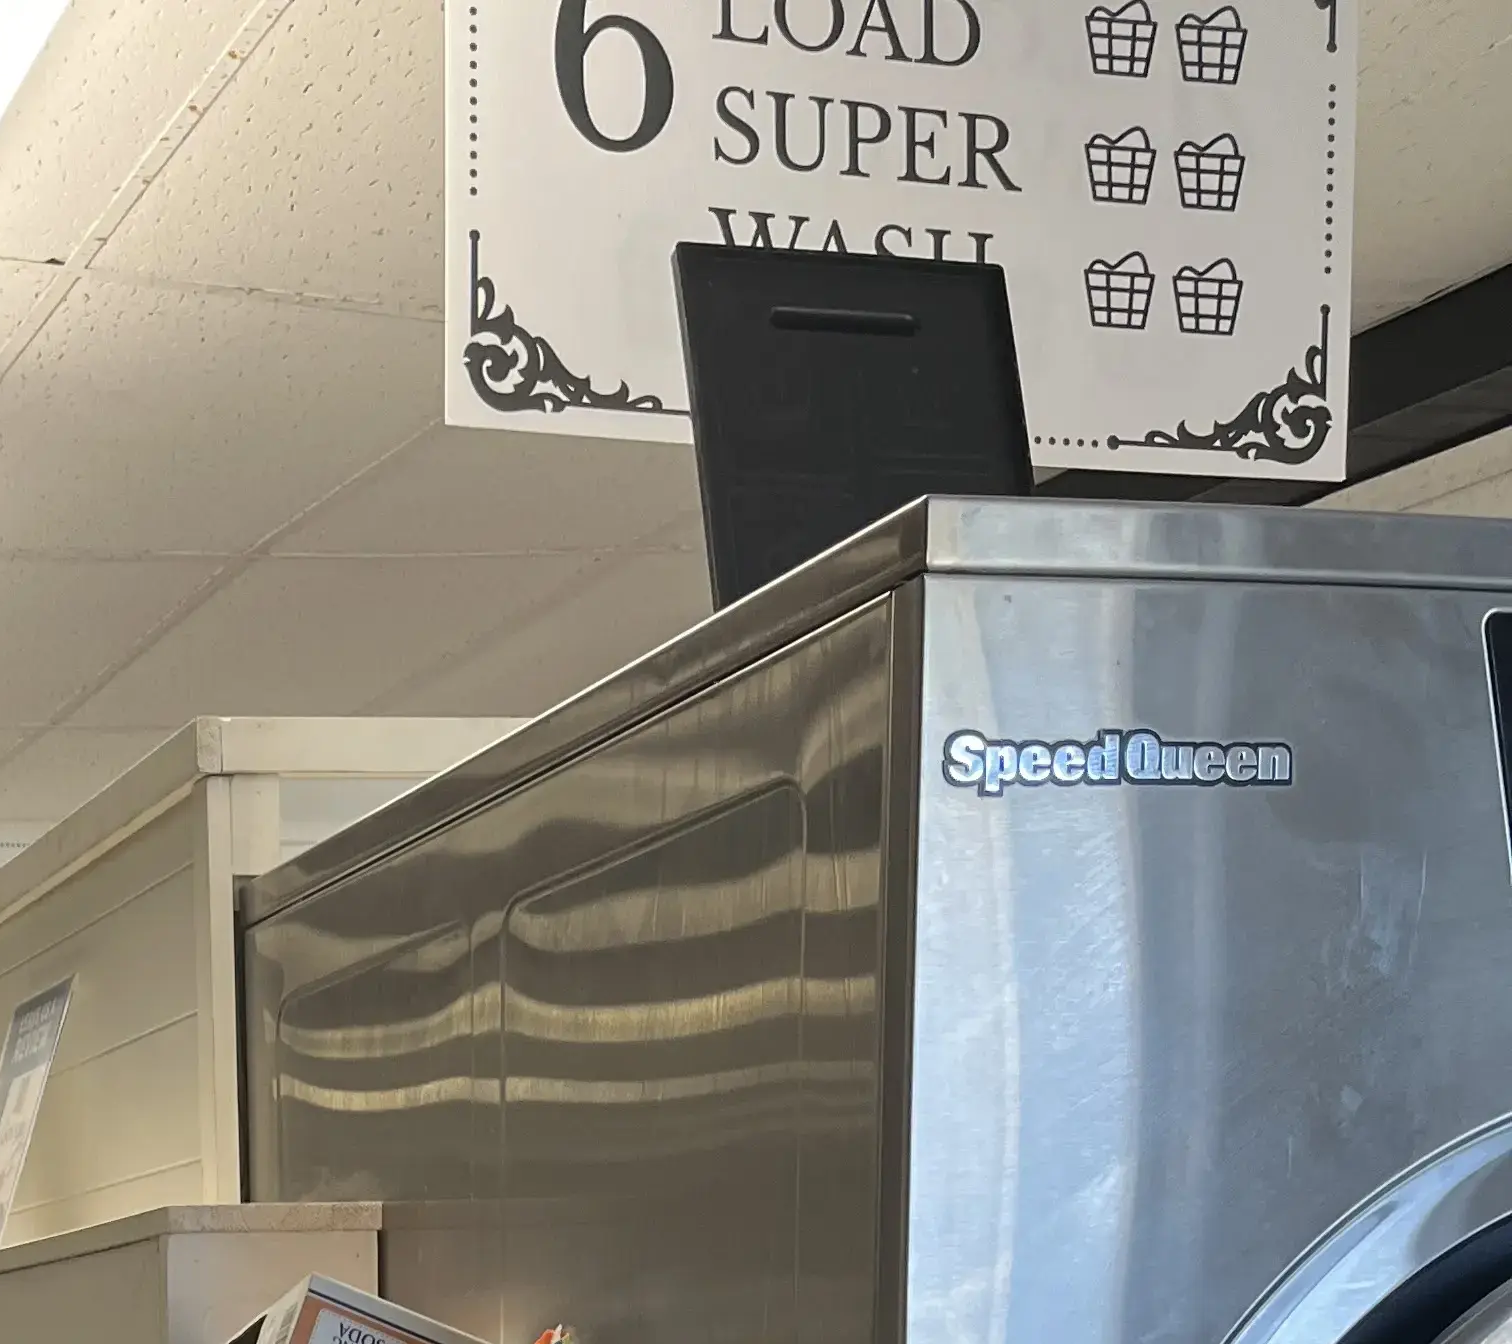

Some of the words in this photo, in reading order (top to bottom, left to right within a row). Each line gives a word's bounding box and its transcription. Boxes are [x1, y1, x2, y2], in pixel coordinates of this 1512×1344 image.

[554, 0, 674, 153] 6
[712, 0, 981, 66] LOAD
[714, 86, 1023, 192] SUPER
[942, 729, 1122, 797] Speed
[1123, 729, 1292, 786] Queen
